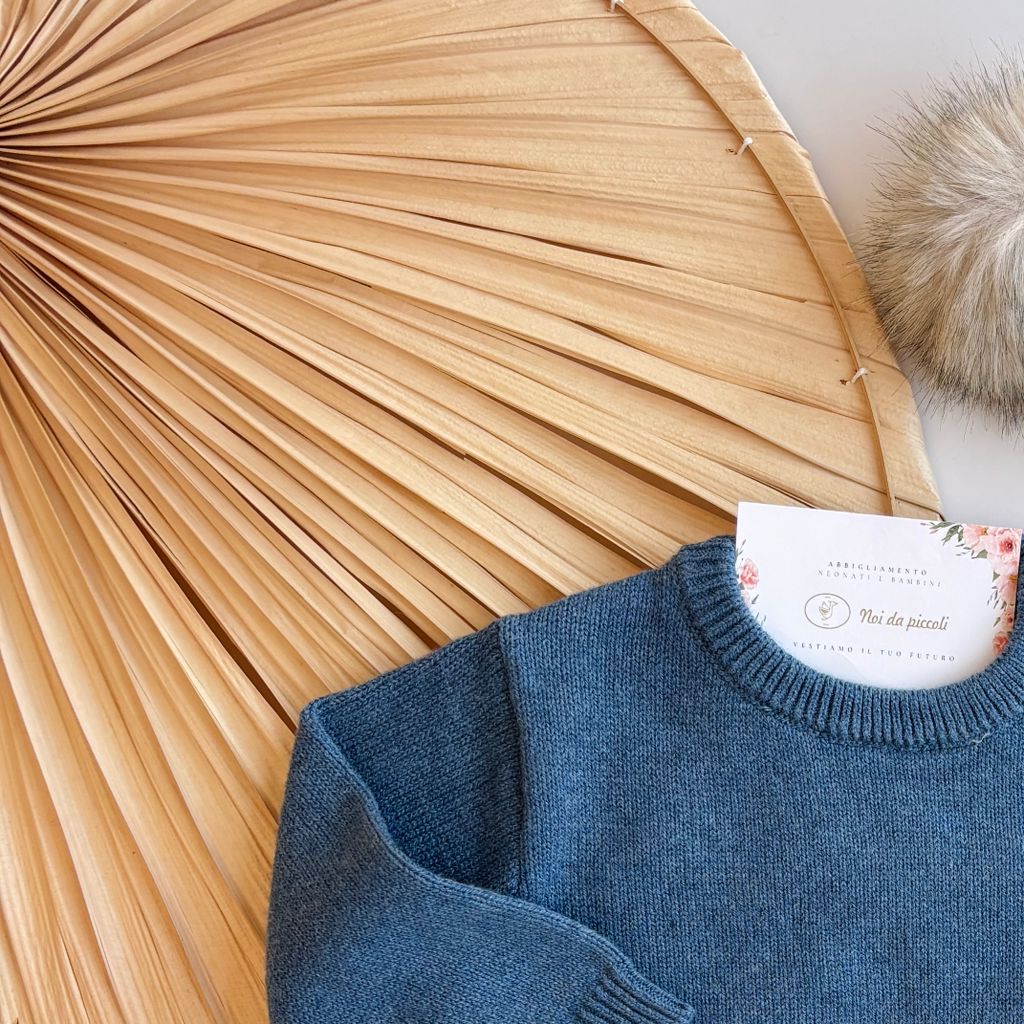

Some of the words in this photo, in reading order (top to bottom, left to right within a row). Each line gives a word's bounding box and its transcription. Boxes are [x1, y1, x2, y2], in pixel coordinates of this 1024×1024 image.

[828, 561, 927, 576] ABBIGLIAMENTO
[818, 570, 870, 581] NEONATI
[891, 577, 941, 587] BAMBINI
[859, 608, 885, 624] Noi
[886, 611, 903, 627] da
[906, 614, 950, 631] piccoli
[793, 641, 853, 653] VESTIAMO
[861, 647, 871, 655] IL
[880, 649, 902, 657] TUO
[909, 652, 955, 662] FUTURO
